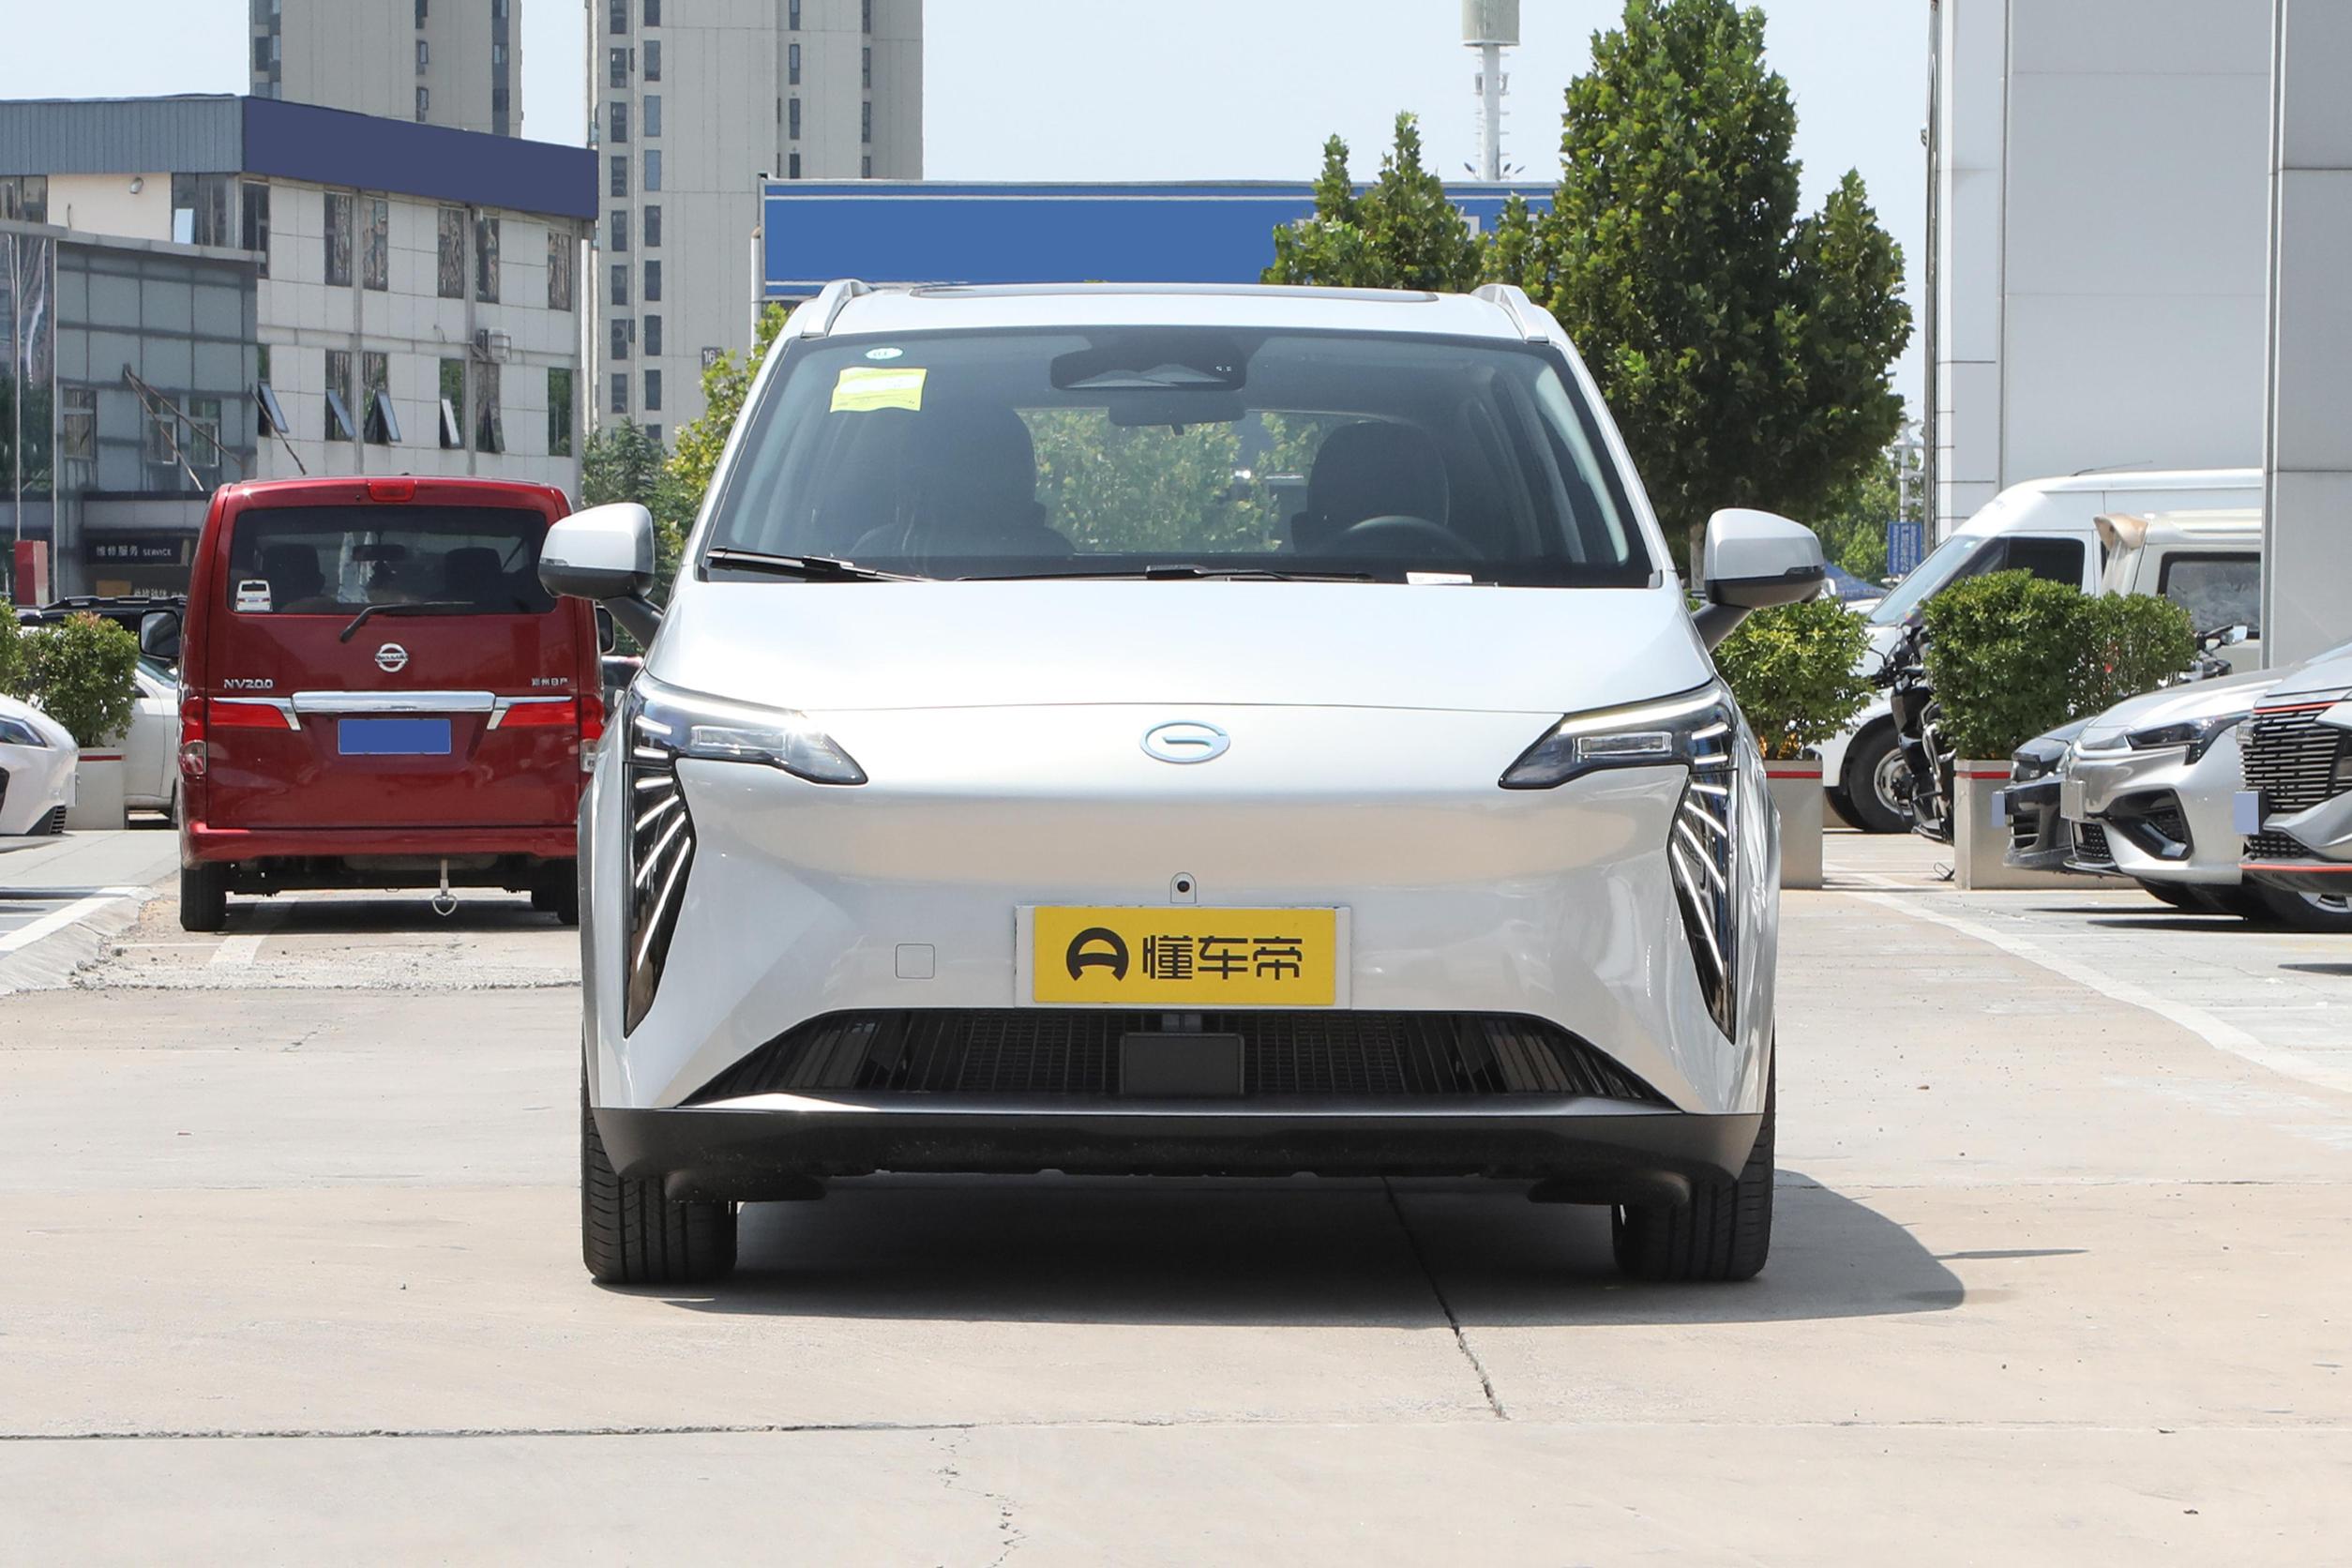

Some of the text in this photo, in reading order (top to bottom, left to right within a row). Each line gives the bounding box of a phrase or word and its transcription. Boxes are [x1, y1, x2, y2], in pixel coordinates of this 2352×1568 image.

[224, 678, 274, 689] NV200
[1142, 935, 1303, 980] 懂车帝
